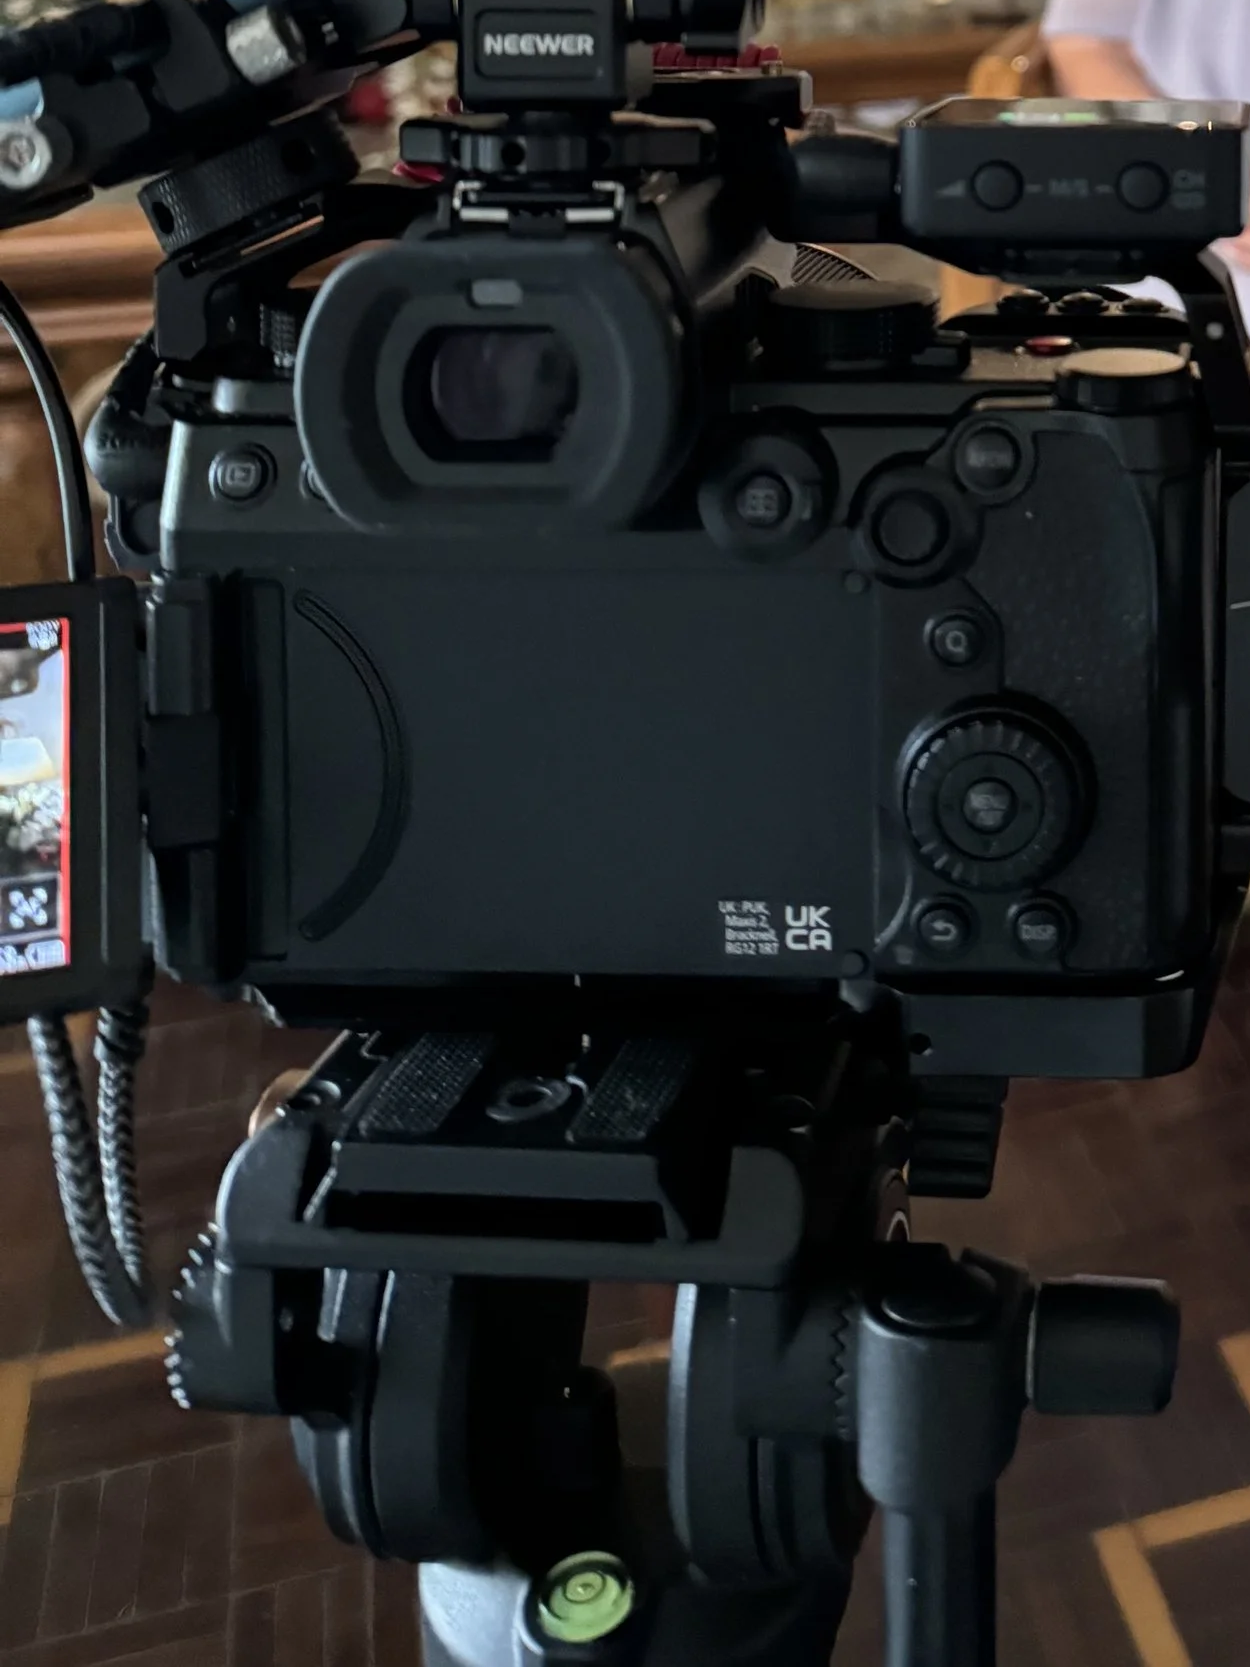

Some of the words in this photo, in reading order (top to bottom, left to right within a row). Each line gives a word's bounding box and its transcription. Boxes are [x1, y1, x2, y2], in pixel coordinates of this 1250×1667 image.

[484, 32, 594, 56] NEEWER
[785, 905, 831, 928] UK
[785, 928, 832, 950] CA
